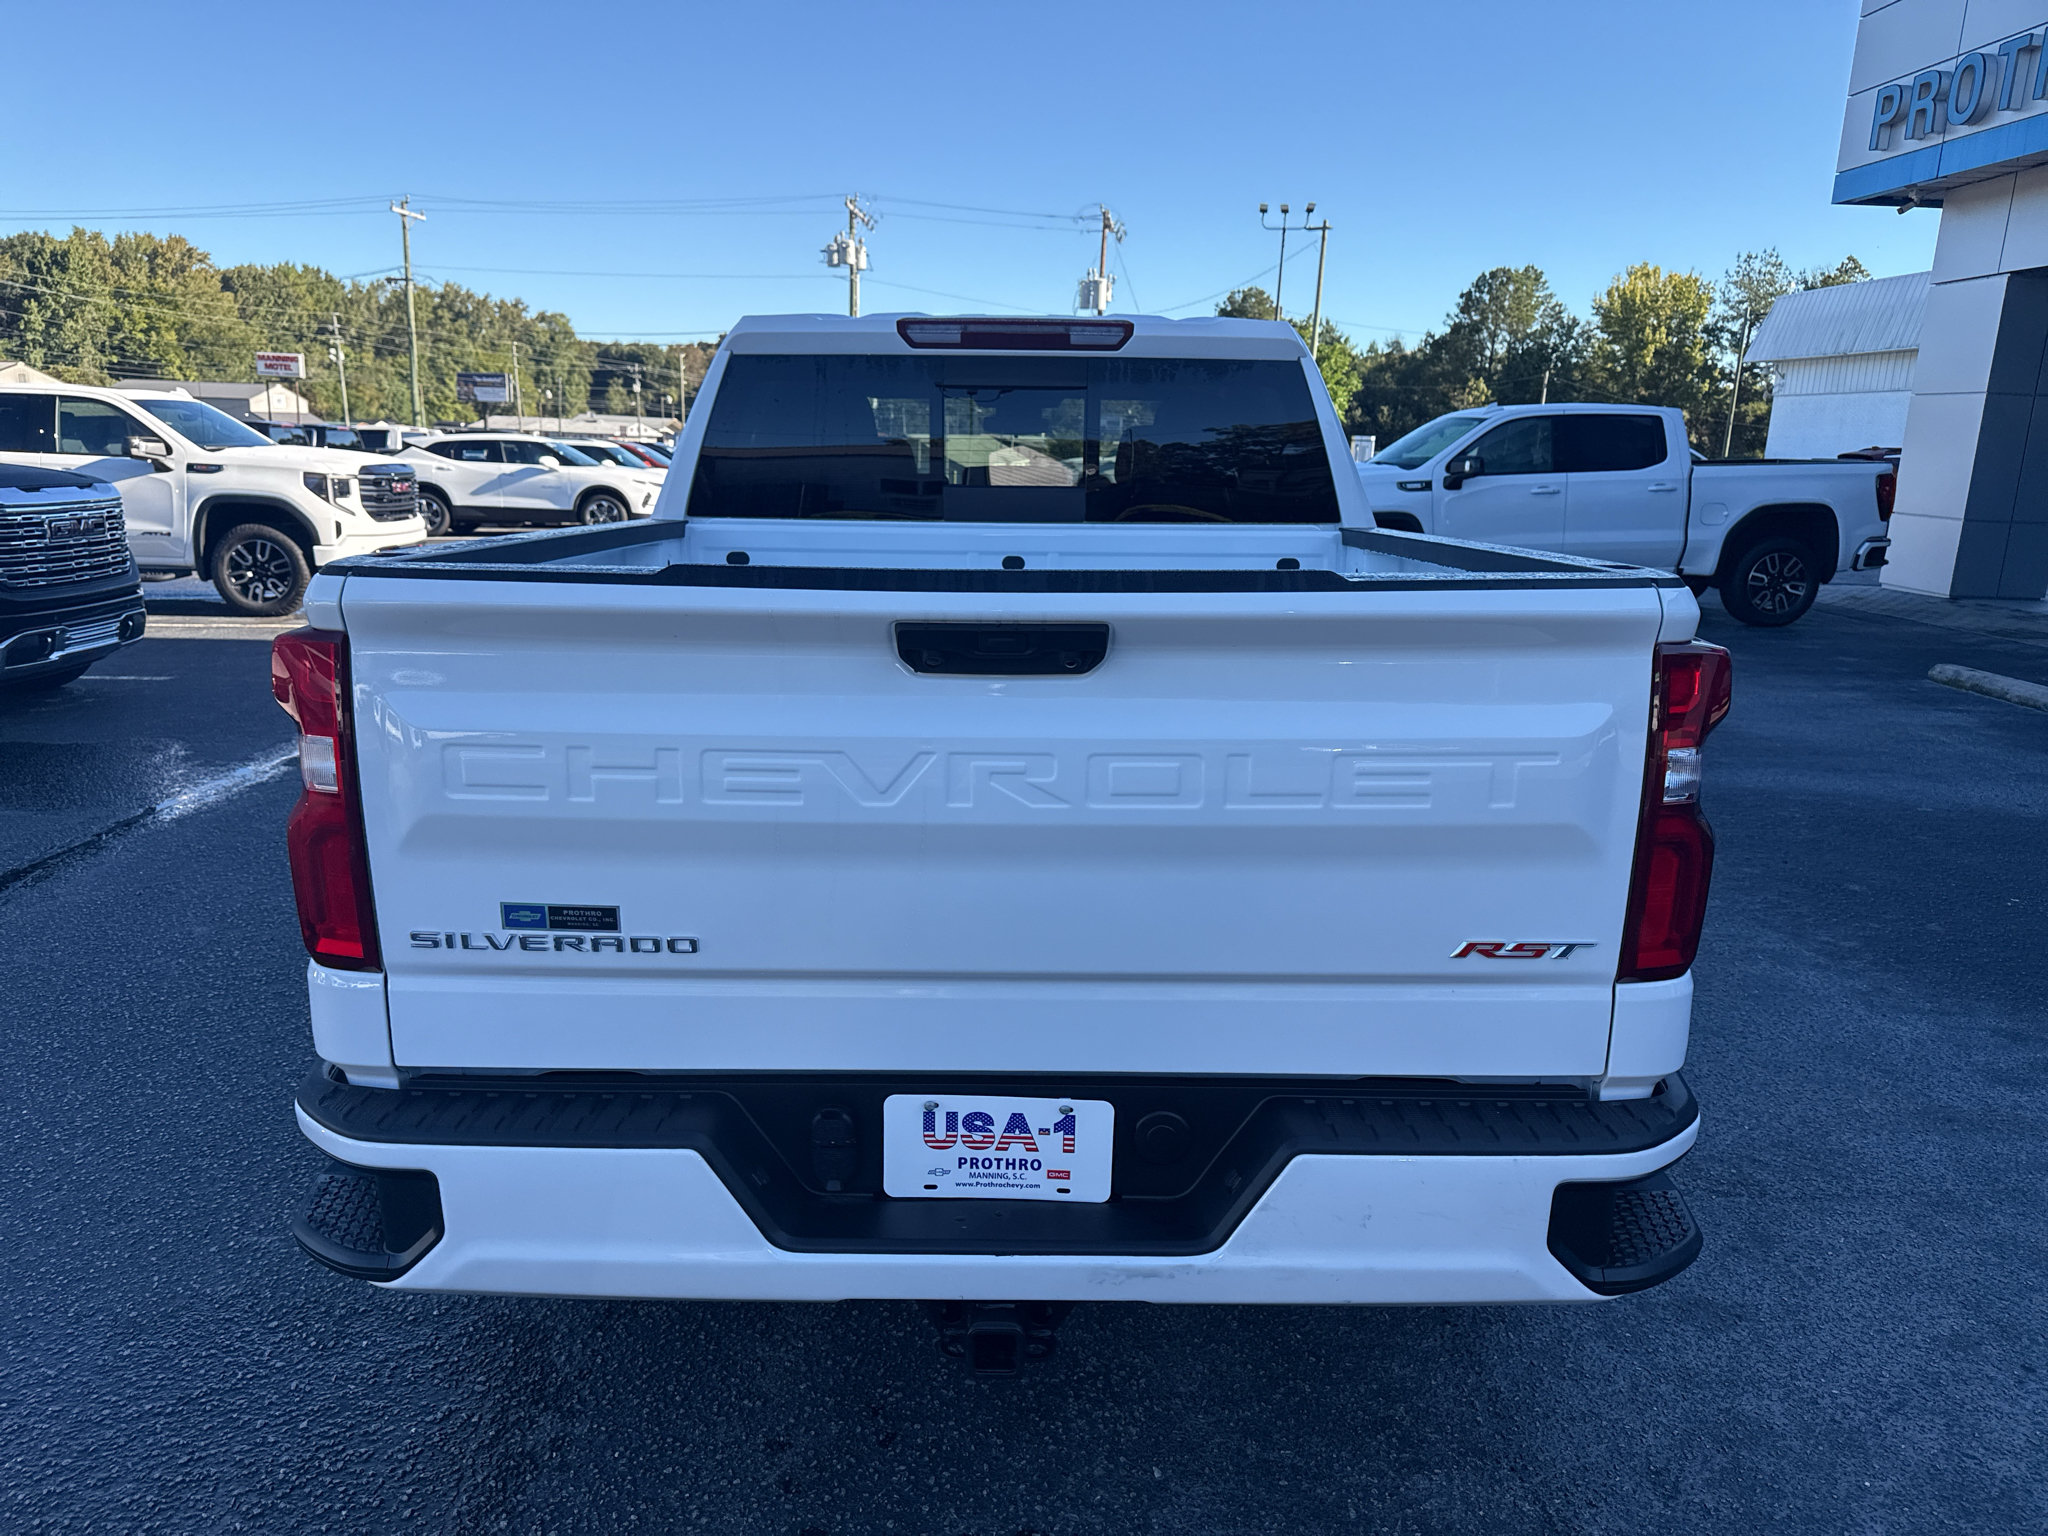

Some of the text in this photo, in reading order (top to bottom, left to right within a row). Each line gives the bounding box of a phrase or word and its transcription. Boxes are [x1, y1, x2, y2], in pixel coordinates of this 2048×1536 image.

[257, 354, 299, 362] MANNING
[264, 362, 293, 371] MOTEL
[51, 518, 106, 539] GMC
[441, 742, 1561, 810] CHEVROLET
[409, 930, 700, 954] SILVERADO
[1449, 940, 1599, 959] RST
[922, 1110, 1076, 1154] USA-1
[957, 1156, 1043, 1172] PROTHRO
[968, 1171, 1028, 1181] MANNING, S.C.
[1048, 1171, 1069, 1179] GMC
[954, 1180, 1042, 1191] www.Prothrochevy.com
